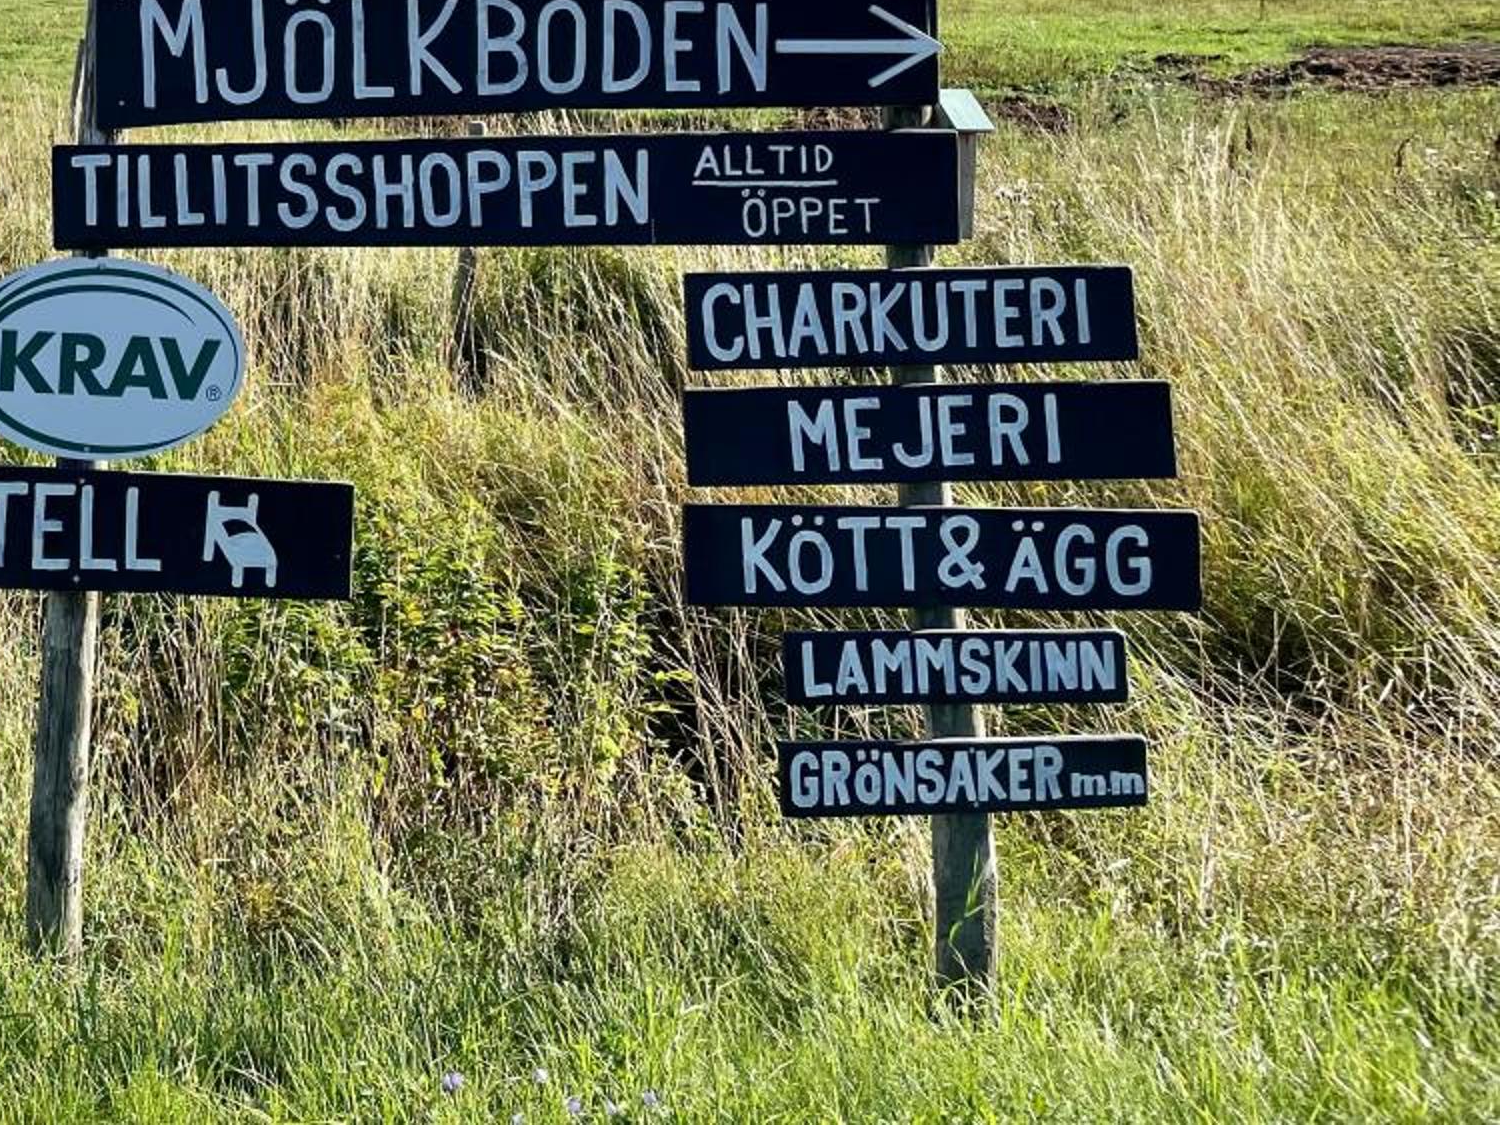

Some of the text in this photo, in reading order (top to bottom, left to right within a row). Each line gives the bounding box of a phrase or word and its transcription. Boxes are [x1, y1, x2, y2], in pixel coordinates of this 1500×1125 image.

[71, 149, 650, 232] TILLITSSHOPPEN
[694, 145, 835, 177] ALLTID
[740, 190, 882, 238] ÖPPET
[701, 278, 1092, 362] CHARKUTERI
[787, 393, 1062, 473] MEJERI
[1005, 520, 1154, 597] ÄGG
[800, 637, 1117, 698] LAMMSKINN
[789, 746, 1065, 809] GRÖNSAKER
